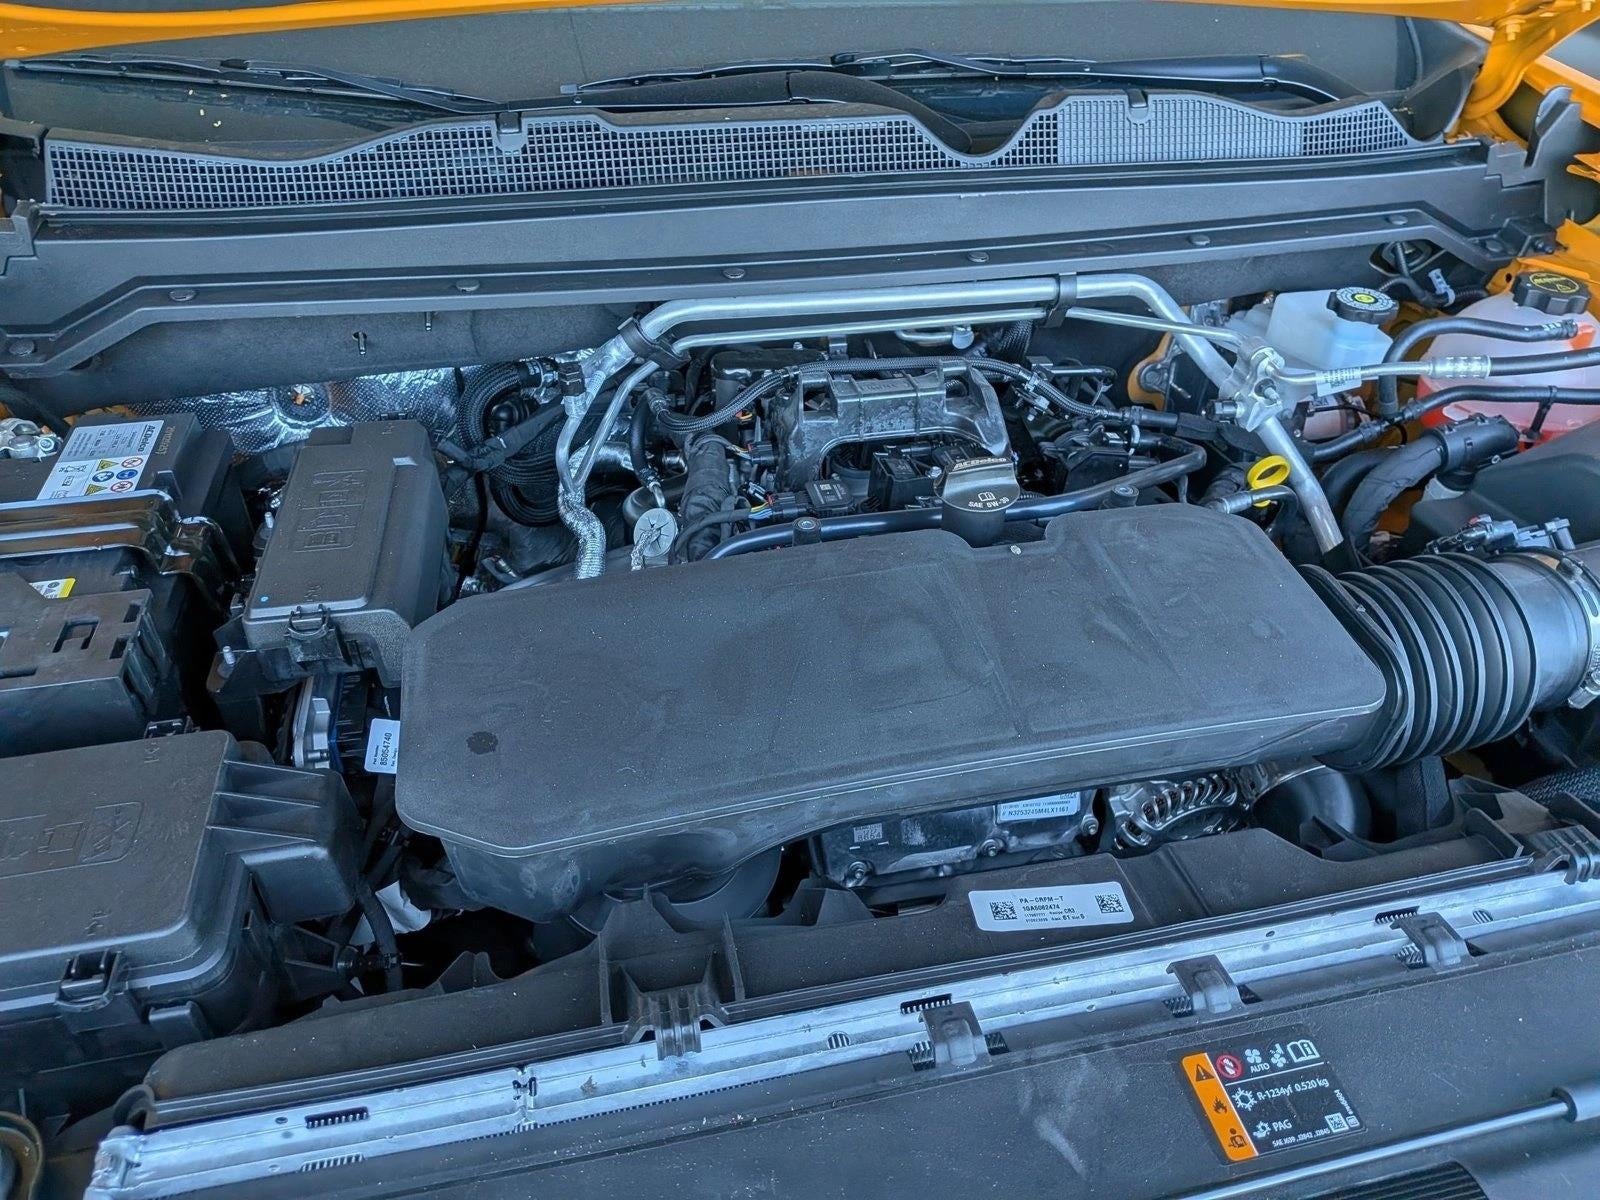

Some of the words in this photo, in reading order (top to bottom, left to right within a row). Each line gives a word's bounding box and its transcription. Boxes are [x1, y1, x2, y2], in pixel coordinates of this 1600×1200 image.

[138, 425, 156, 452] ACDelco
[953, 458, 1007, 471] ACDelco
[968, 500, 984, 508] SAE
[1250, 1062, 1270, 1074] AUTO
[1256, 1085, 1293, 1101] R-1234yf
[1294, 1080, 1316, 1093] 0.520
[1315, 1077, 1329, 1089] kg
[1272, 1119, 1293, 1132] PAG
